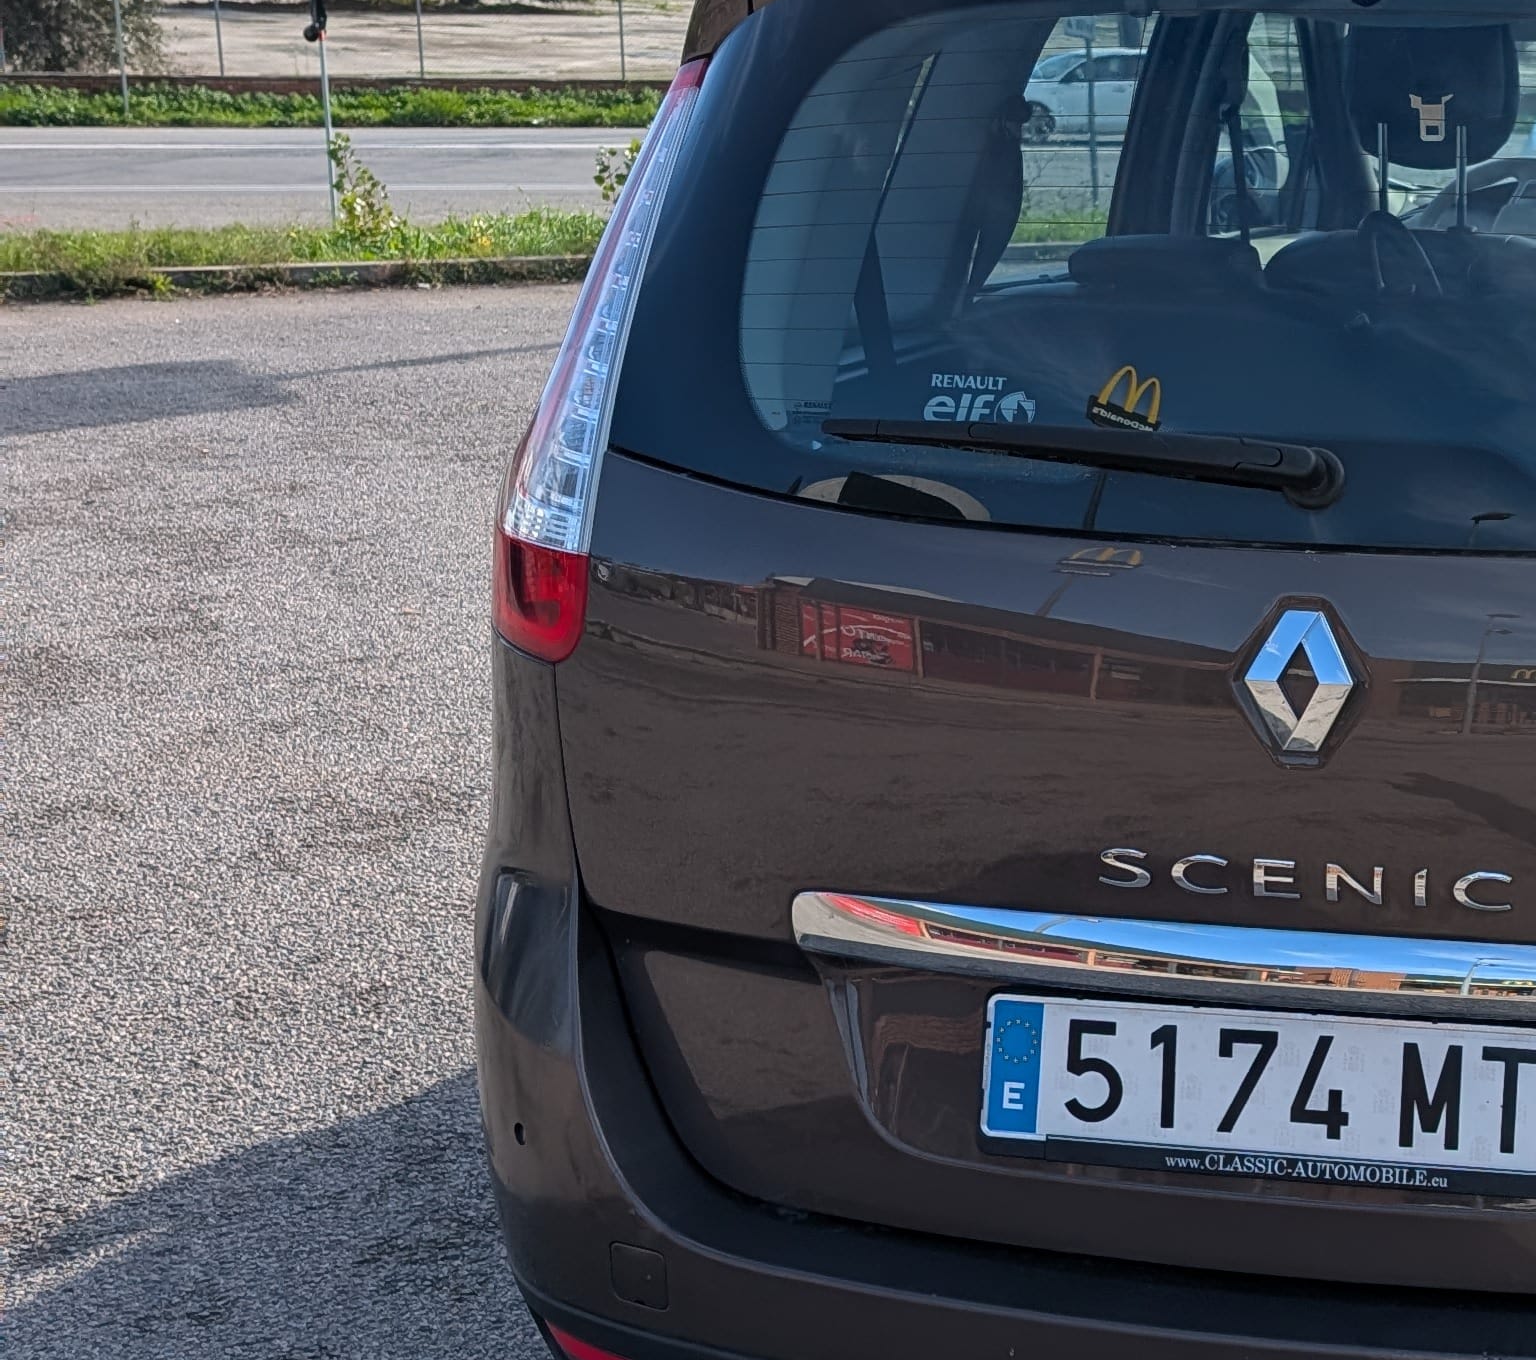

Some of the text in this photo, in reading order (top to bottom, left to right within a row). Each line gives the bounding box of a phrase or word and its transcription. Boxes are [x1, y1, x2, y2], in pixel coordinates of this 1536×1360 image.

[931, 373, 1008, 390] RENAULT
[924, 393, 995, 422] elf
[1099, 848, 1513, 911] SCENIC
[1002, 1081, 1025, 1110] E
[1064, 1019, 1350, 1140] 5174
[1165, 1153, 1449, 1188] www.CLASSIC-AUTOMOBILE.eu
